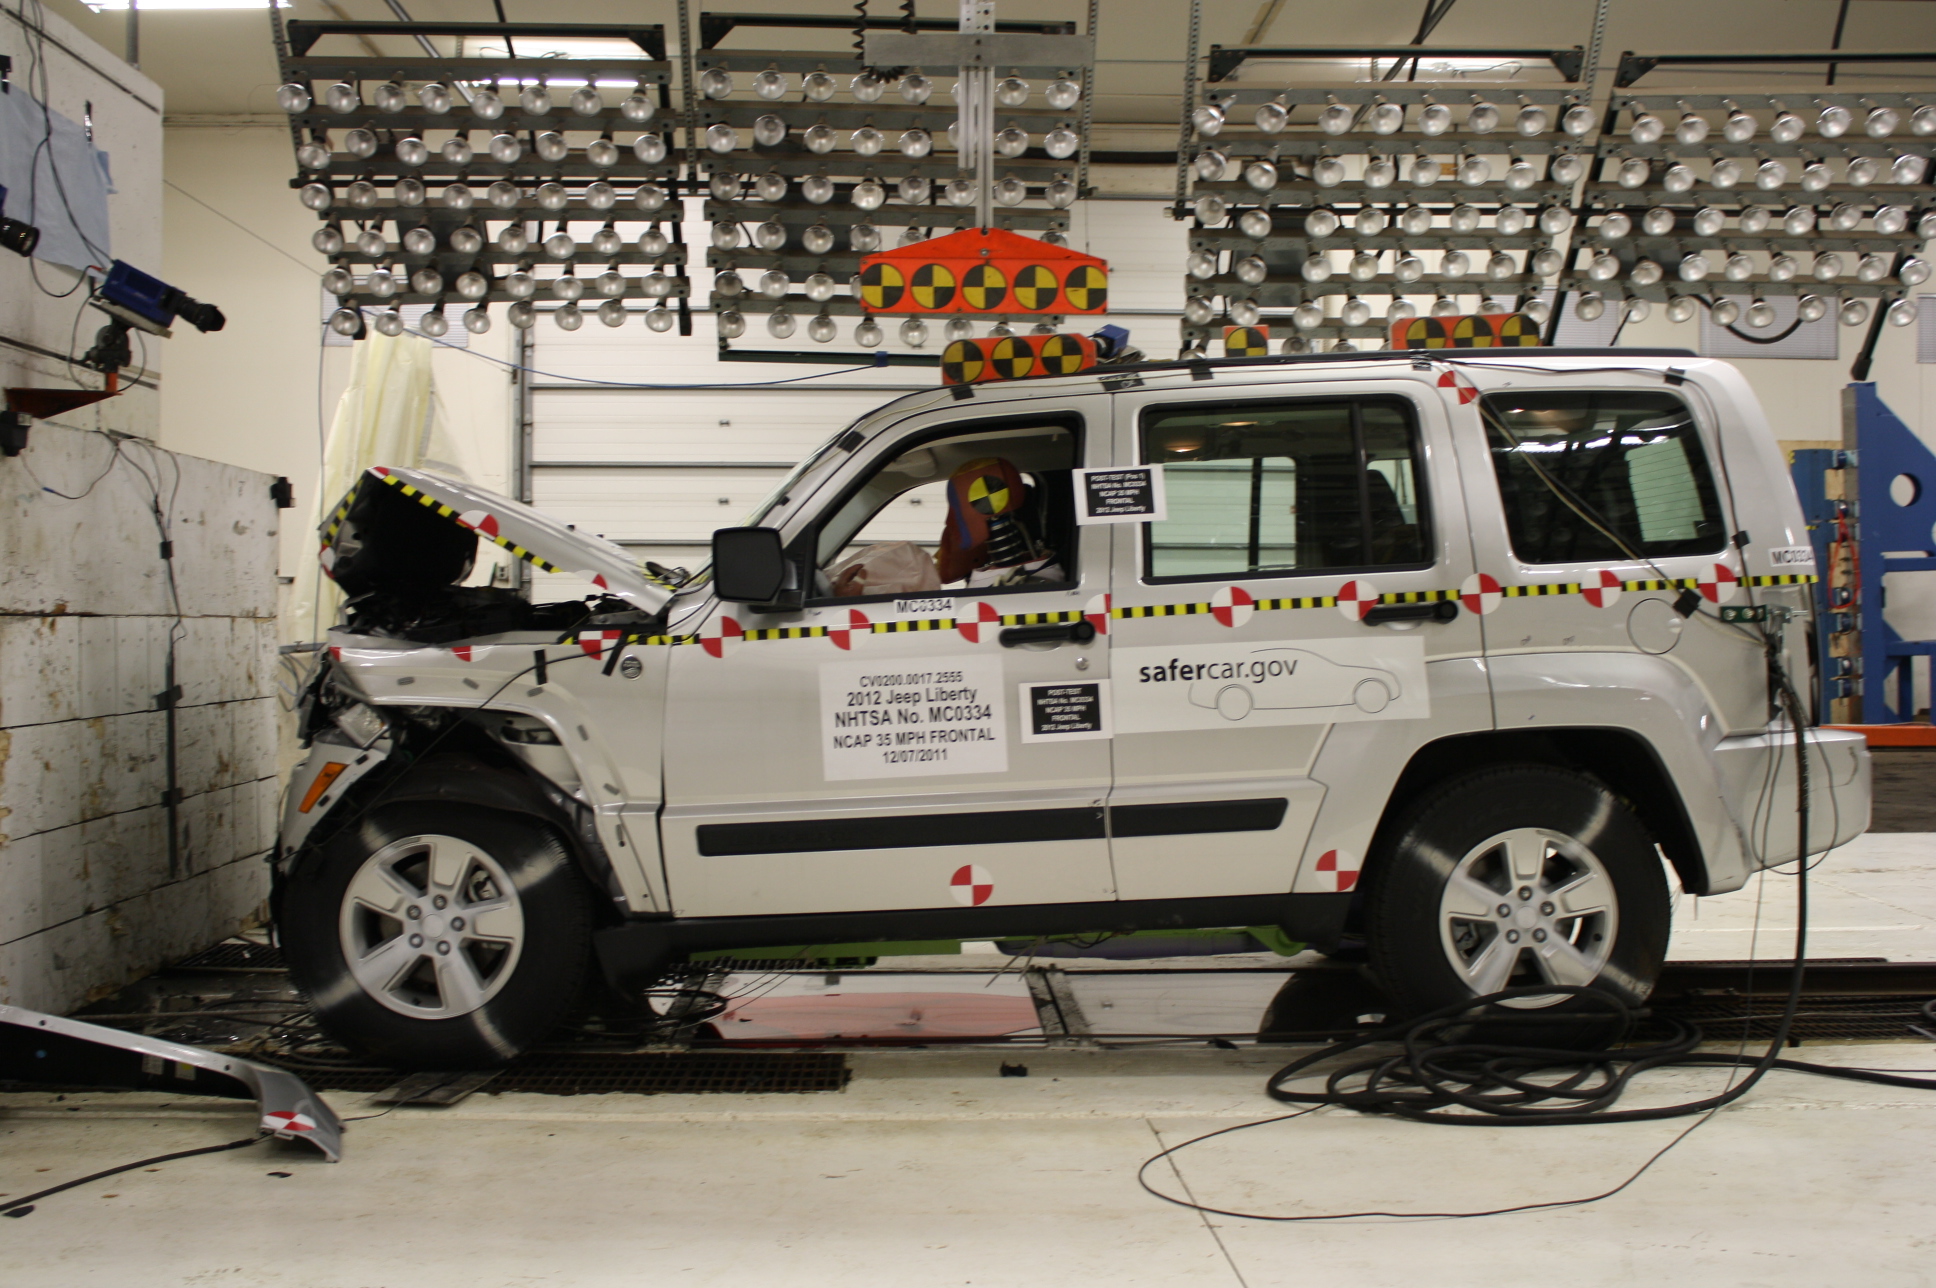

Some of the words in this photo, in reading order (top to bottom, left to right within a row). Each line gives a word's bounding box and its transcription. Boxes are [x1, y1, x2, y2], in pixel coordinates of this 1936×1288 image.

[897, 599, 952, 613] MC0334
[859, 671, 963, 687] CV0200.0017.2555
[1139, 658, 1298, 683] safercar.gov
[847, 690, 881, 707] 2012
[886, 690, 921, 706] Jeep
[926, 687, 977, 703] Liberty
[835, 709, 893, 728] NHTSA
[897, 709, 924, 724] No.
[929, 704, 992, 722] MC0334
[833, 734, 872, 749] NCAP
[876, 733, 892, 746] 35
[895, 731, 926, 745] MPH
[930, 728, 995, 743] FRONTAL
[882, 748, 948, 763] 12/07/2011
